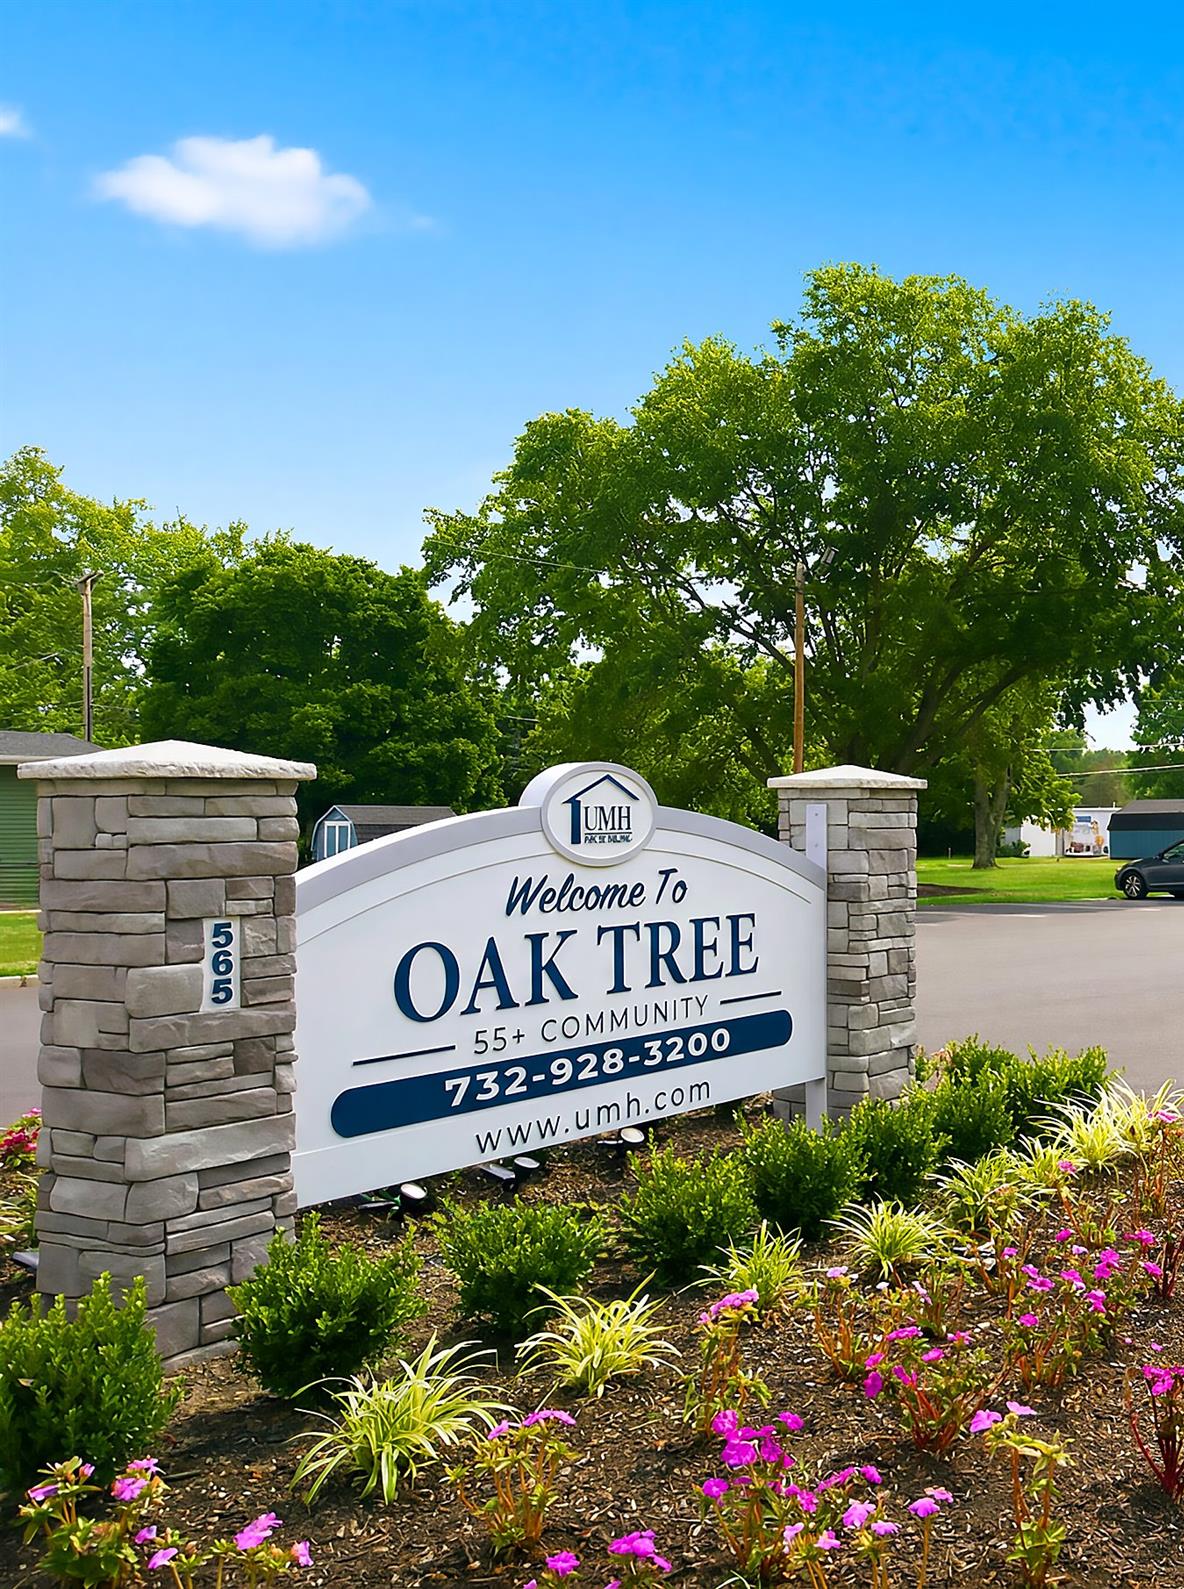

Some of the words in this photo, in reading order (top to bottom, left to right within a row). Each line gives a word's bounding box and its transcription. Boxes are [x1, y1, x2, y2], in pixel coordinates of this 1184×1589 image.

[583, 806, 632, 831] UMH
[505, 874, 646, 917] Welcome
[656, 868, 688, 905] To
[211, 922, 234, 1005] 565
[393, 929, 579, 1023] OAK
[596, 912, 759, 995] TREE
[473, 1029, 526, 1054] 55+
[541, 995, 709, 1042] COMMUNITY
[444, 1027, 731, 1106] 732-928-3200
[475, 1078, 711, 1154] www.umh.com
